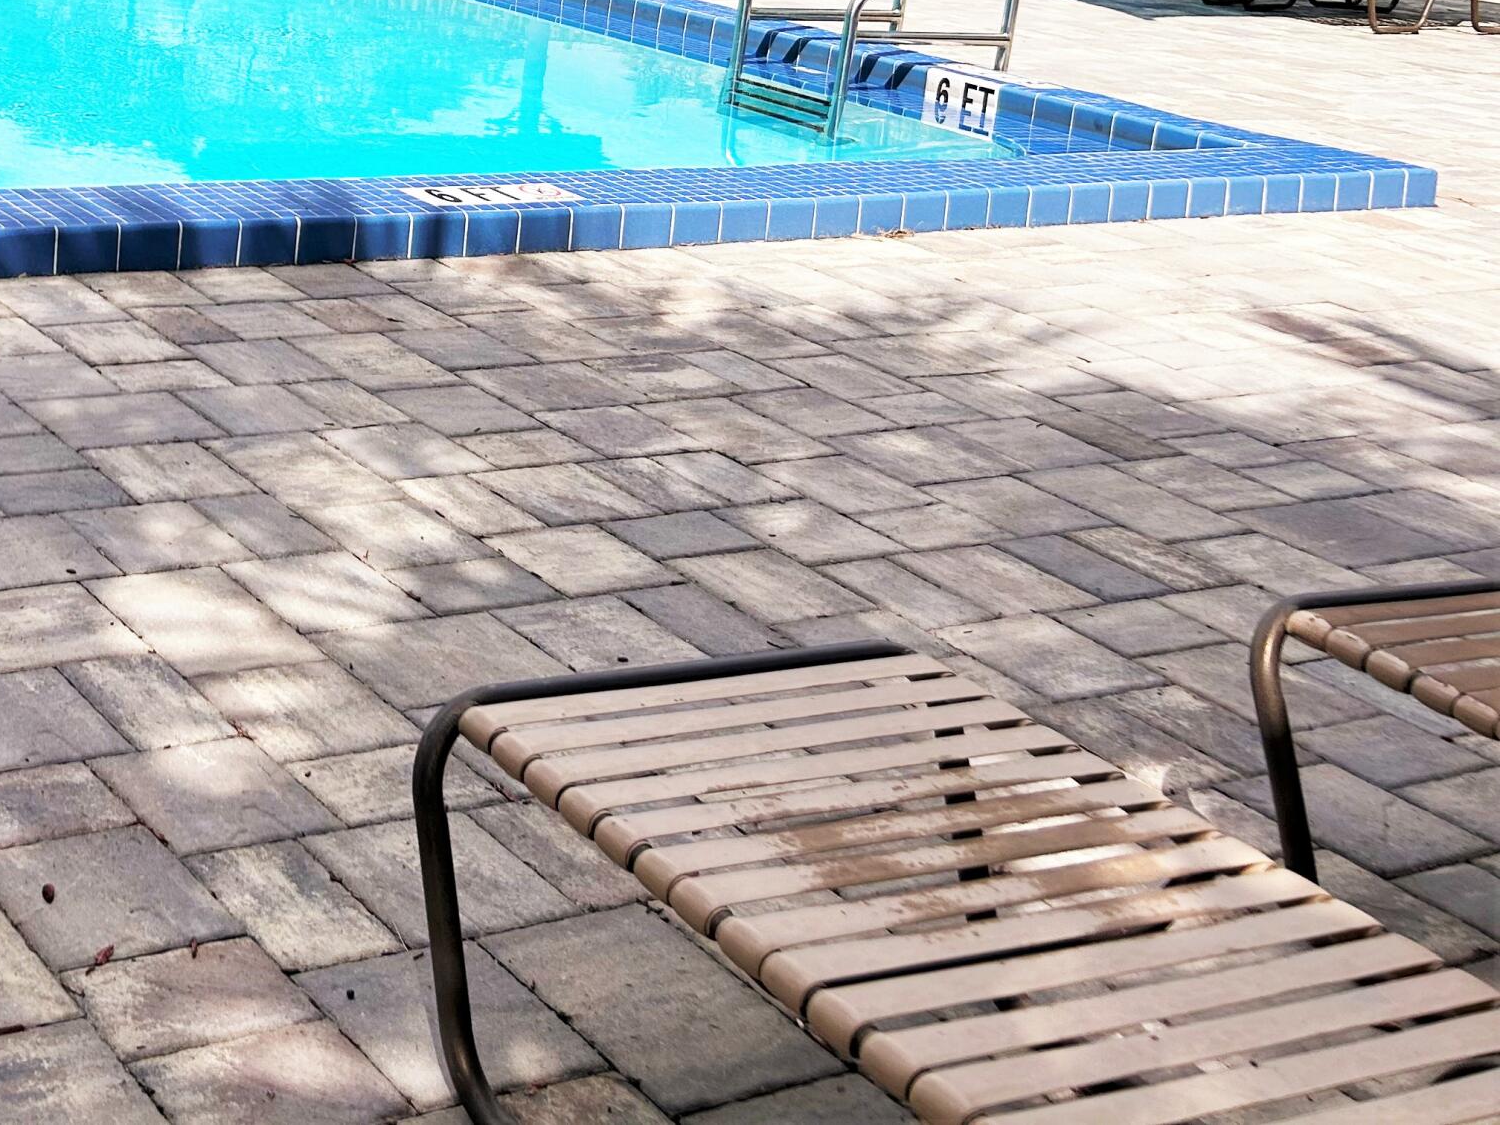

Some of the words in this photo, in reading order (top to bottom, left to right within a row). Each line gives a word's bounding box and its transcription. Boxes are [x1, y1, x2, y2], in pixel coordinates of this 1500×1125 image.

[934, 77, 950, 107] 6
[424, 189, 463, 203] 6
[460, 186, 522, 202] FT
